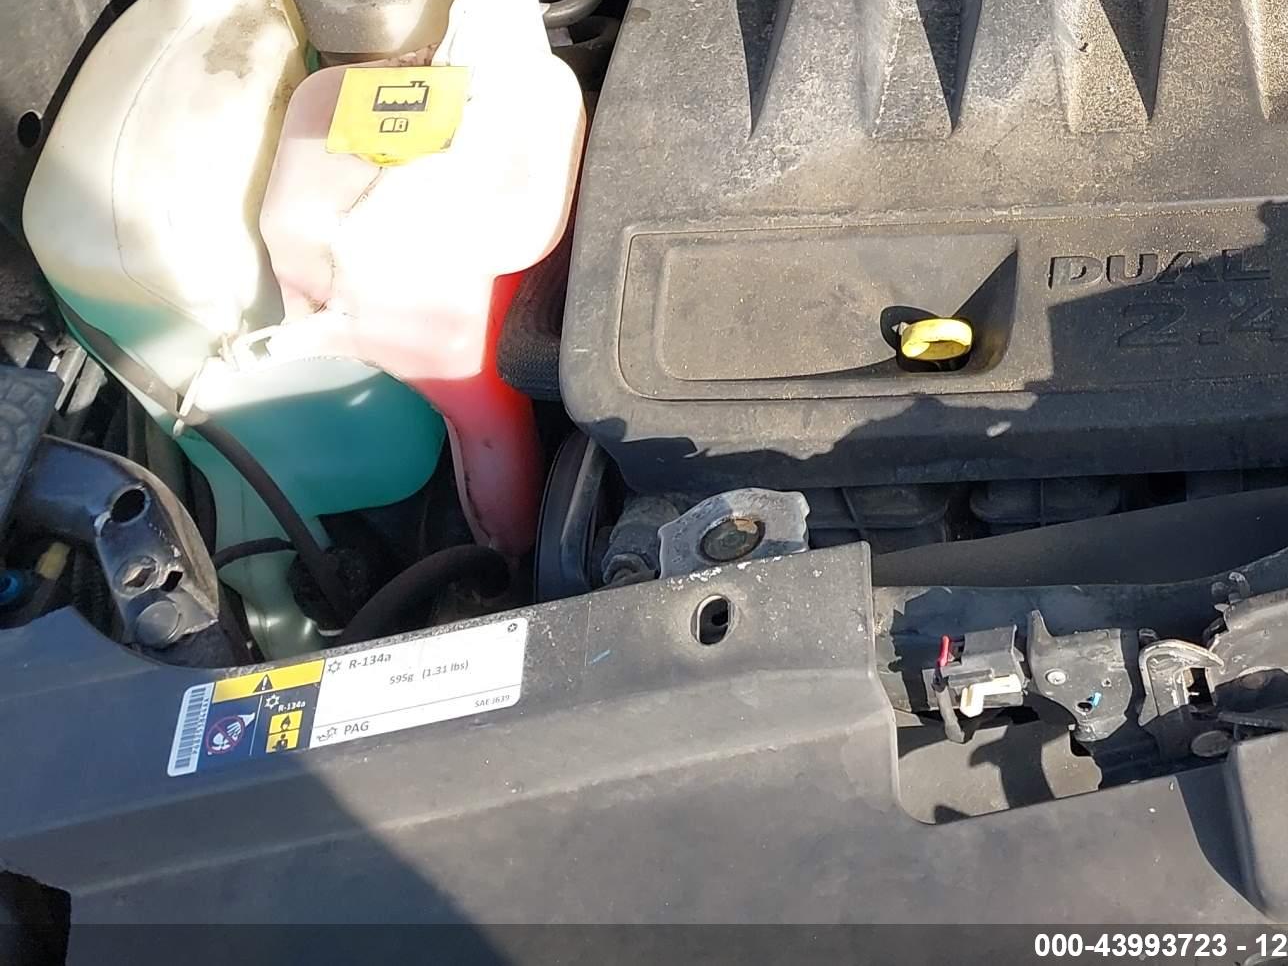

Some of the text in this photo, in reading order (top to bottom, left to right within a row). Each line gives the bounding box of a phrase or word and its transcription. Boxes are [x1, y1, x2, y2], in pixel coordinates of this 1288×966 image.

[1047, 248, 1272, 289] DUAL
[348, 652, 392, 670] R-134a
[389, 658, 470, 685] 595g (1.31 lbs)
[277, 700, 306, 713] R-134a
[474, 697, 491, 708] SAE
[343, 720, 370, 736] PAG
